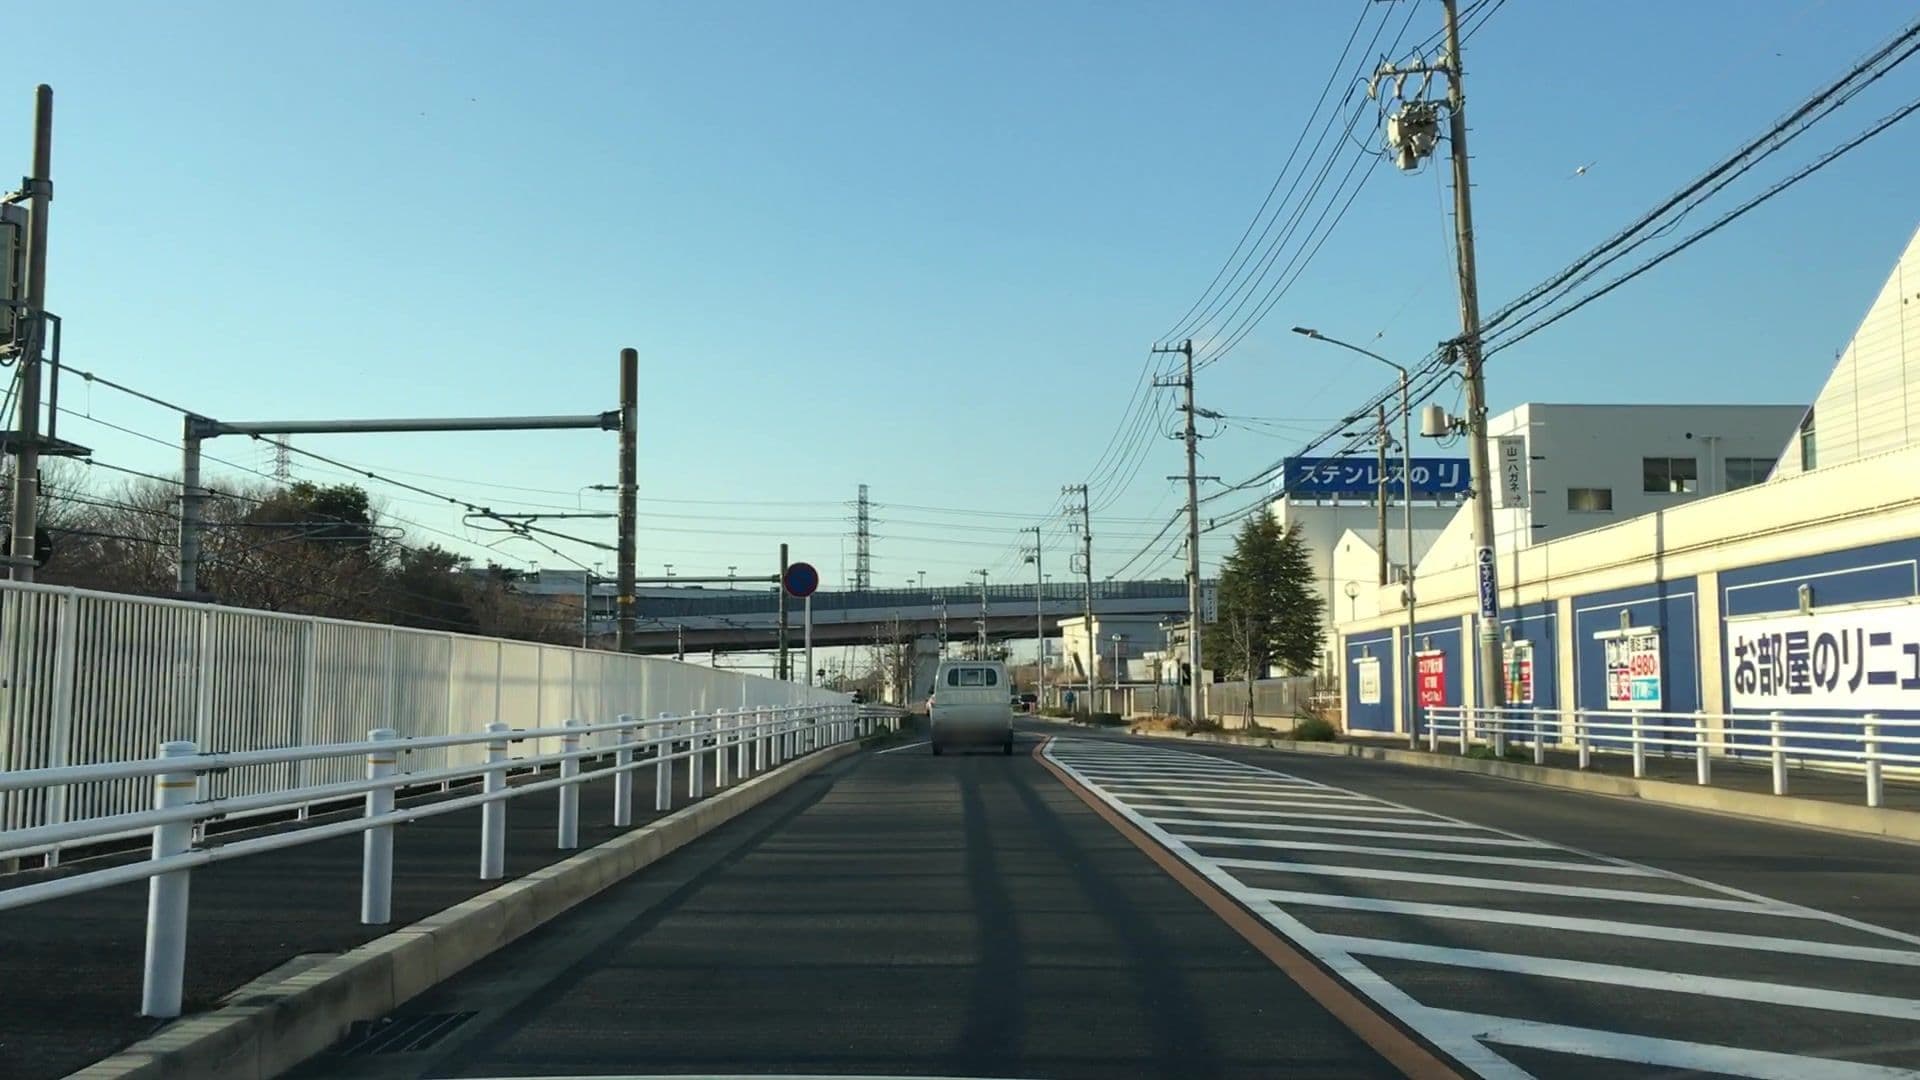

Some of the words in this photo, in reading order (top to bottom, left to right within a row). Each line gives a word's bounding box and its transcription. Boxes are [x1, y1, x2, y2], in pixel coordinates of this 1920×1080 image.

[1735, 628, 1920, 696] お部屋のリニュ
